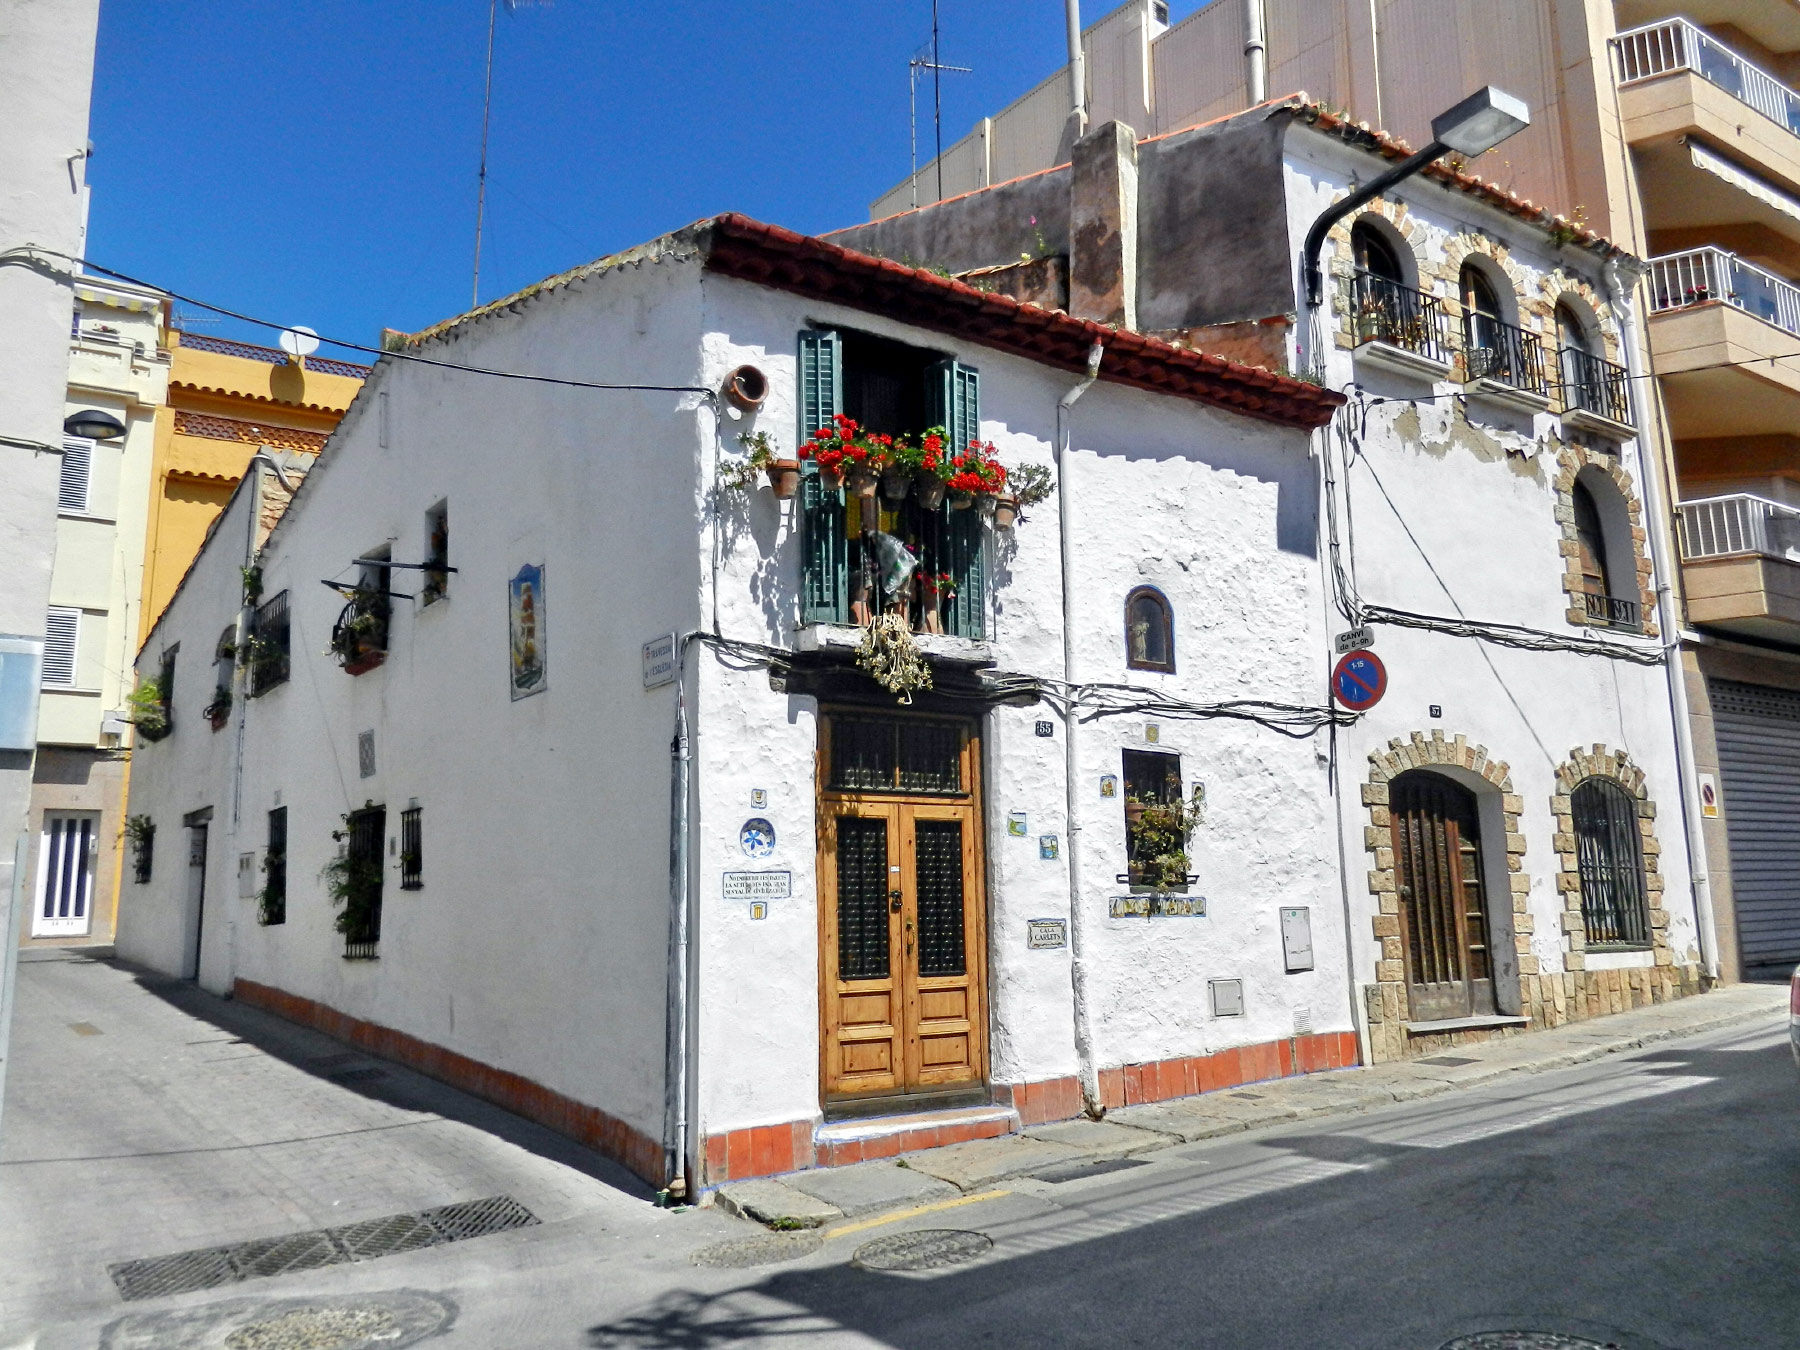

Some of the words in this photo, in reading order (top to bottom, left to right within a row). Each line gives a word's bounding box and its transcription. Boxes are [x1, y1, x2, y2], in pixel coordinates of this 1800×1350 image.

[1341, 630, 1364, 642] CANVI
[1340, 643, 1349, 651] de
[1351, 637, 1370, 648] 8-9h
[1351, 660, 1364, 670] 1-15
[1039, 721, 1052, 734] 55
